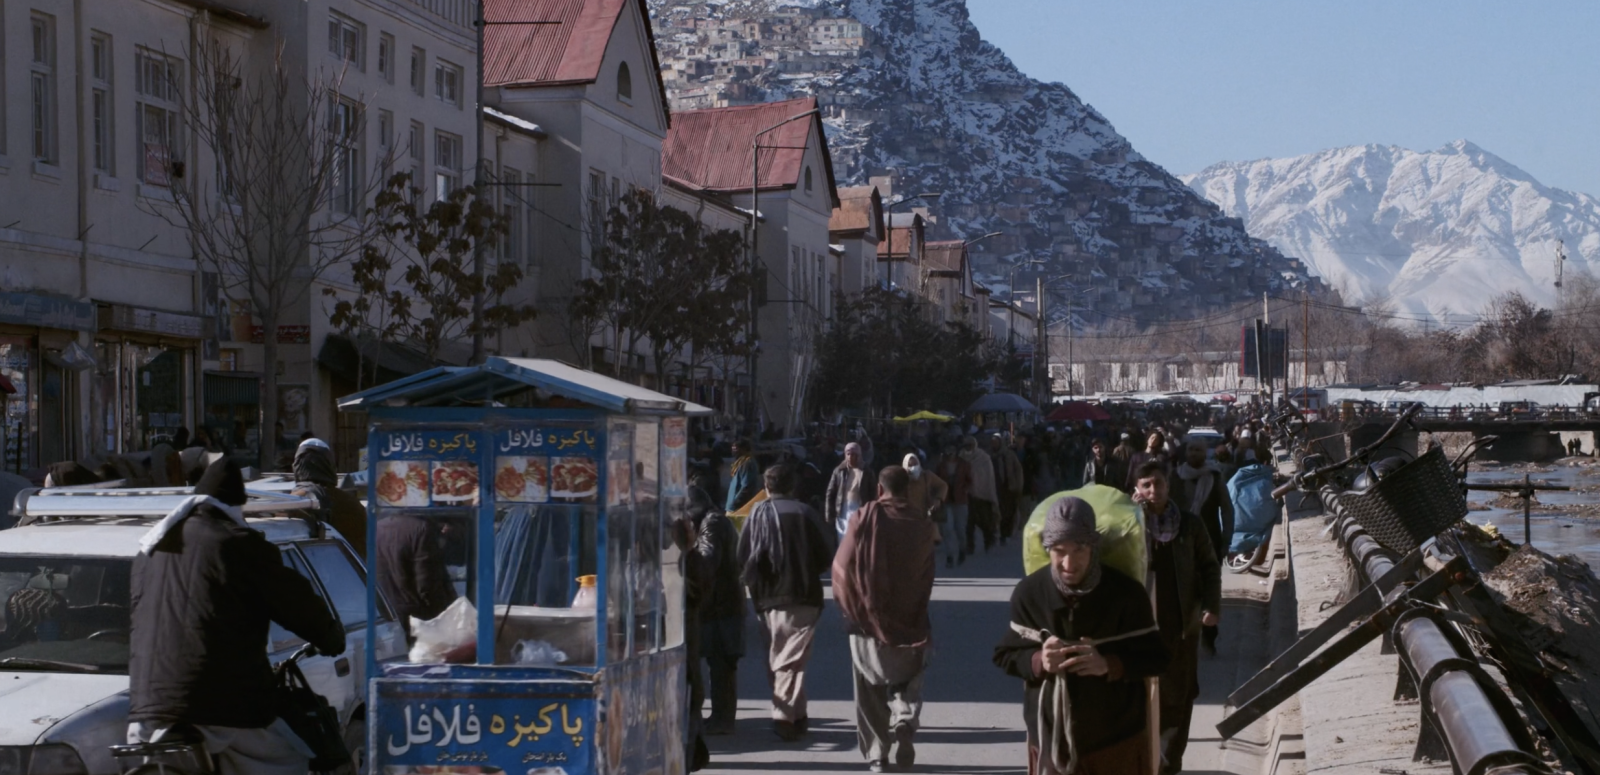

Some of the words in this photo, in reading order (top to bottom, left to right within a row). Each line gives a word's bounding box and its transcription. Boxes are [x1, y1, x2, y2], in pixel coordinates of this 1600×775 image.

[381, 432, 424, 457] فلافل
[428, 433, 477, 455] پاکیزه
[500, 428, 543, 452] فلافل
[548, 430, 596, 450] پاکیزه
[388, 703, 482, 756] فلافل
[490, 703, 584, 747] پاکیزه
